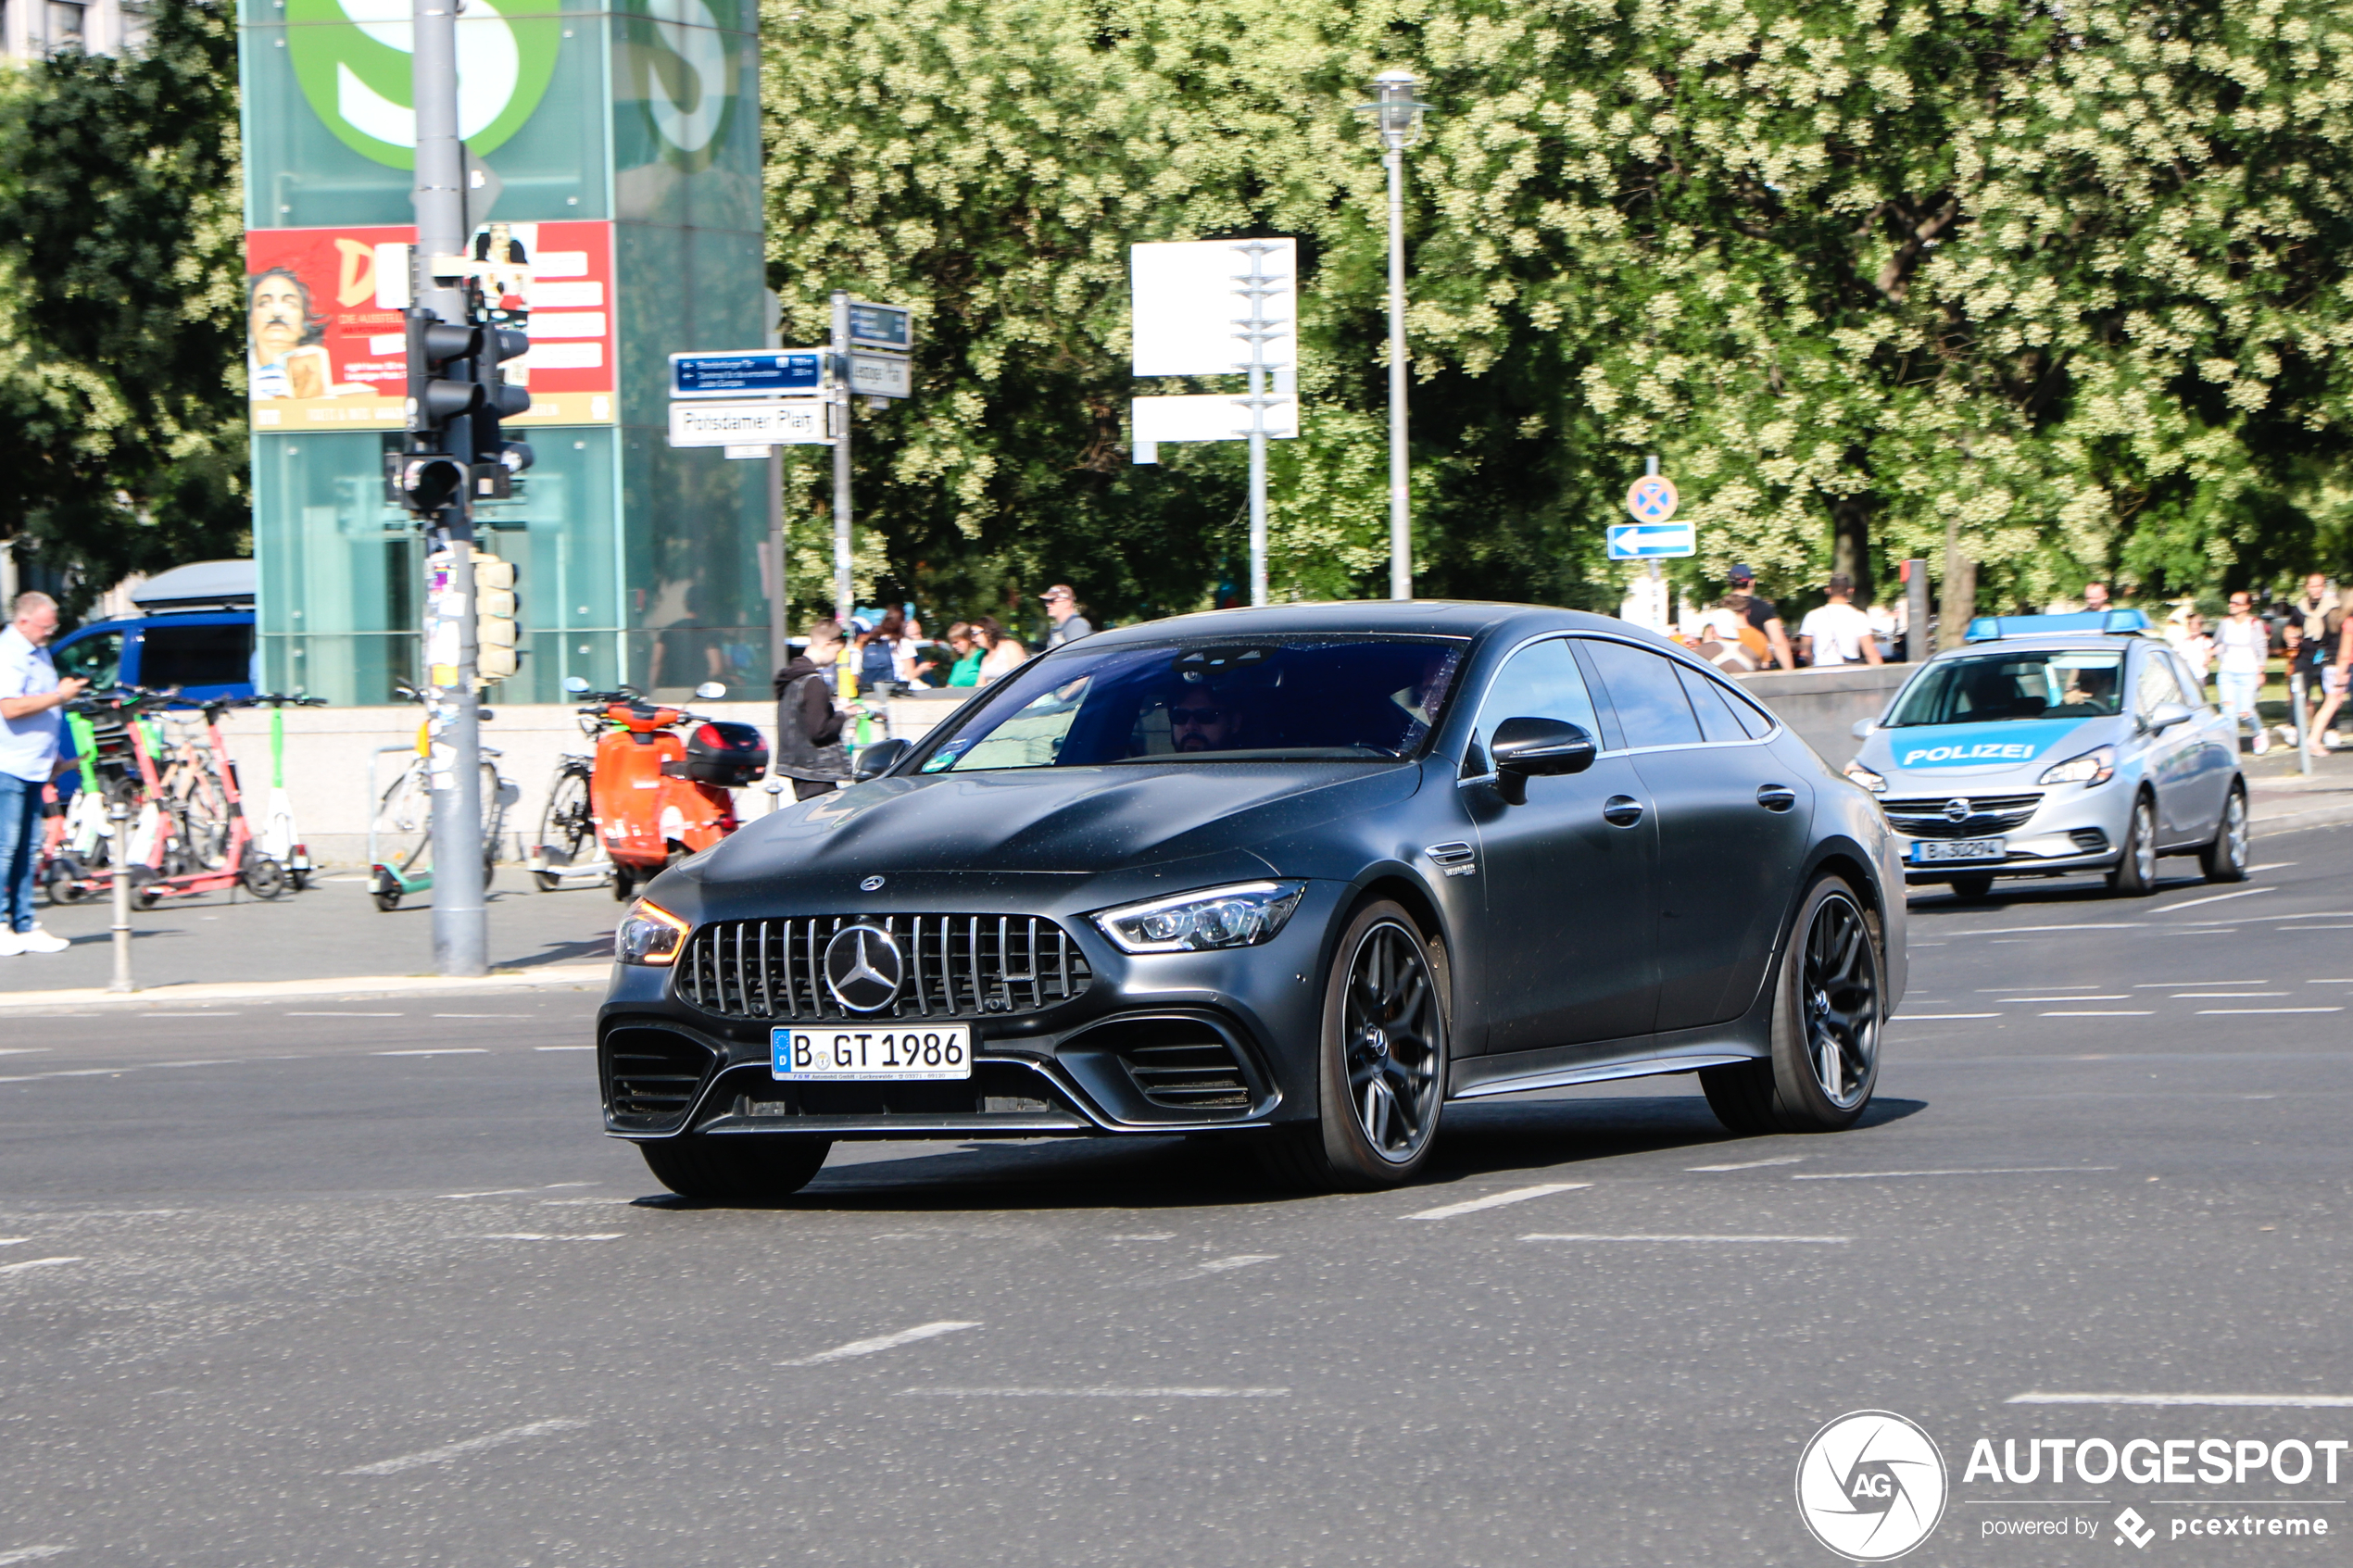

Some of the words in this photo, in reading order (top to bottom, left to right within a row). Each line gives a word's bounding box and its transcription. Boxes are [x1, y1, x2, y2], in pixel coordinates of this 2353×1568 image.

[684, 411, 772, 432] Potsdamer
[777, 409, 814, 433] Platz
[1904, 744, 2035, 766] POLIZEI
[1928, 844, 1938, 859] B
[779, 1055, 786, 1066] D
[794, 1035, 812, 1067] B
[834, 1035, 872, 1067] GT
[881, 1034, 963, 1067] 1986
